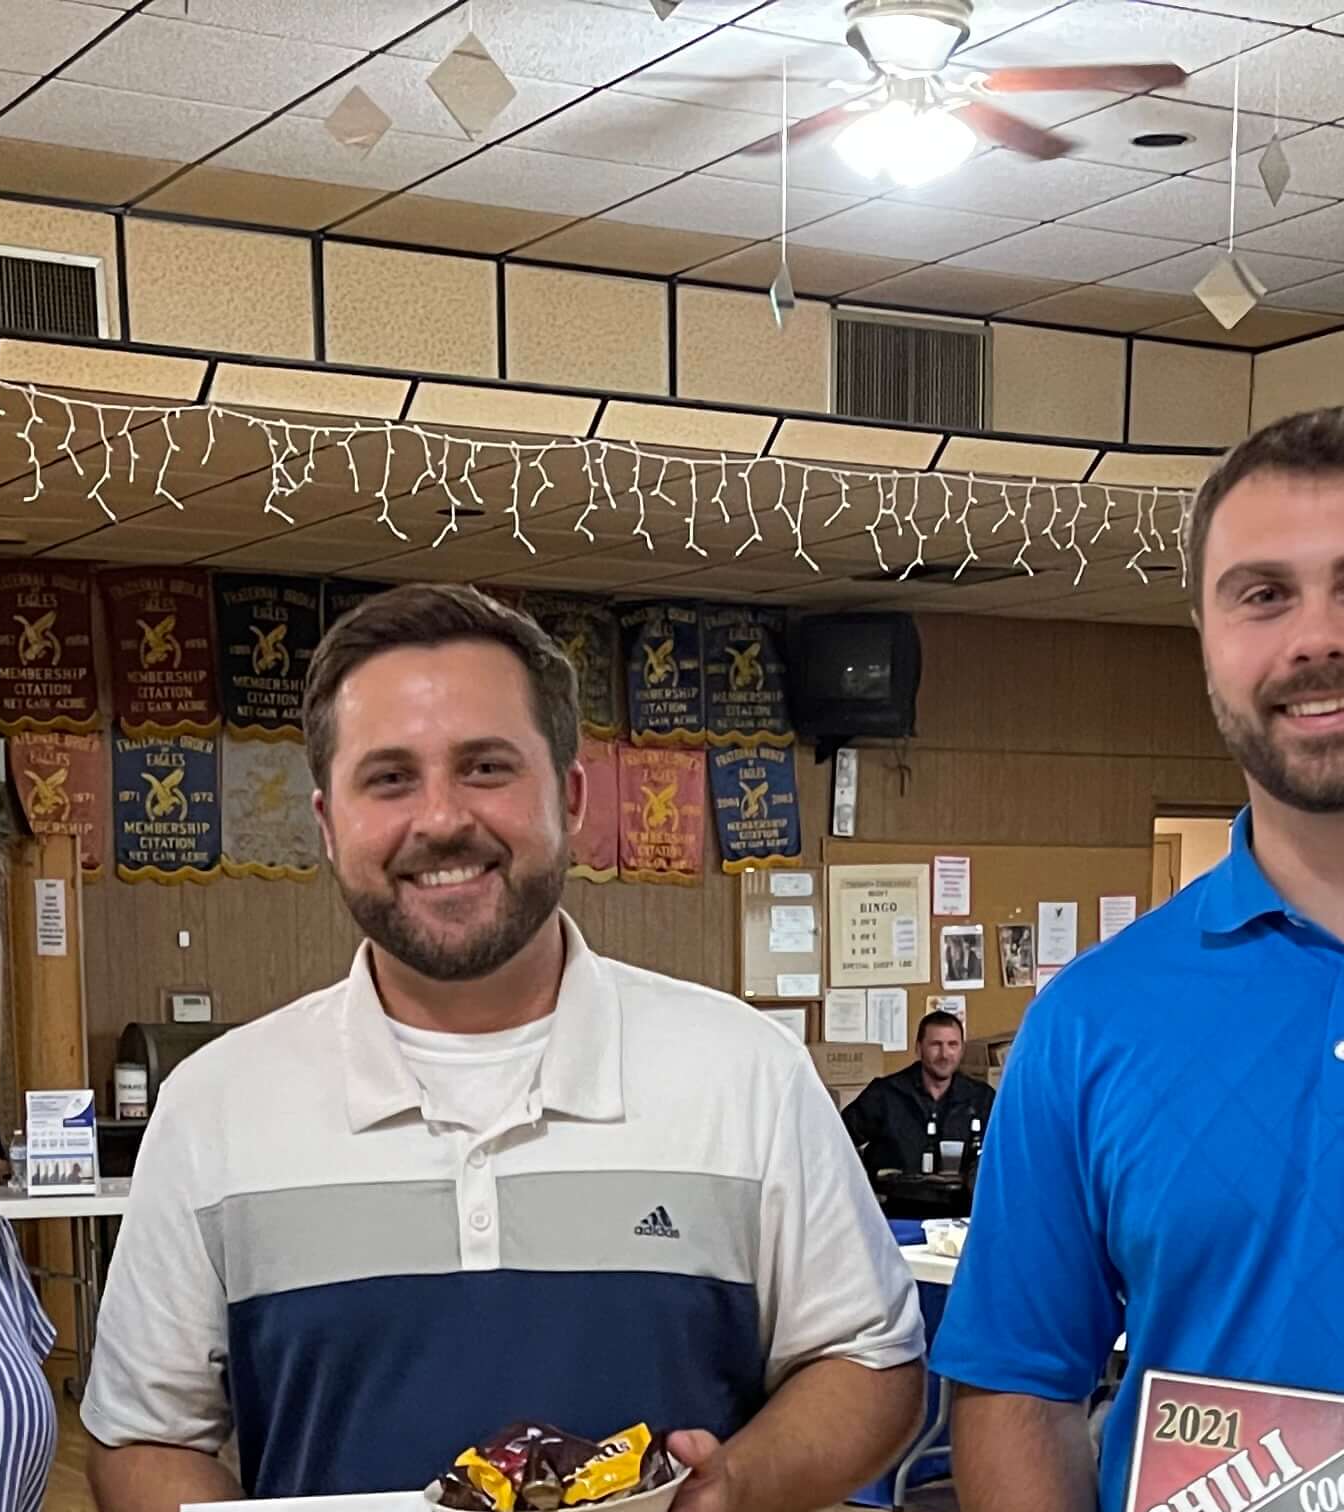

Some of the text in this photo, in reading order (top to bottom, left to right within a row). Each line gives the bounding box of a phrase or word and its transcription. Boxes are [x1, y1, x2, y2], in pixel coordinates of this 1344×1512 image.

[127, 670, 208, 683] MEMBERSHIP
[232, 674, 305, 692] MEMBERSHI
[14, 682, 73, 696] CITATION
[138, 686, 193, 699] CITATION
[247, 691, 300, 705] CITATION
[145, 752, 186, 767] EAGLES
[739, 767, 766, 780] EAGLES
[123, 821, 210, 835] MEMBERSHIP
[727, 818, 788, 832] MEMBERSHIP
[140, 836, 197, 849] CITATION
[860, 902, 898, 913] BINGO
[634, 1225, 681, 1239] adidas
[1155, 1403, 1240, 1450] 2021
